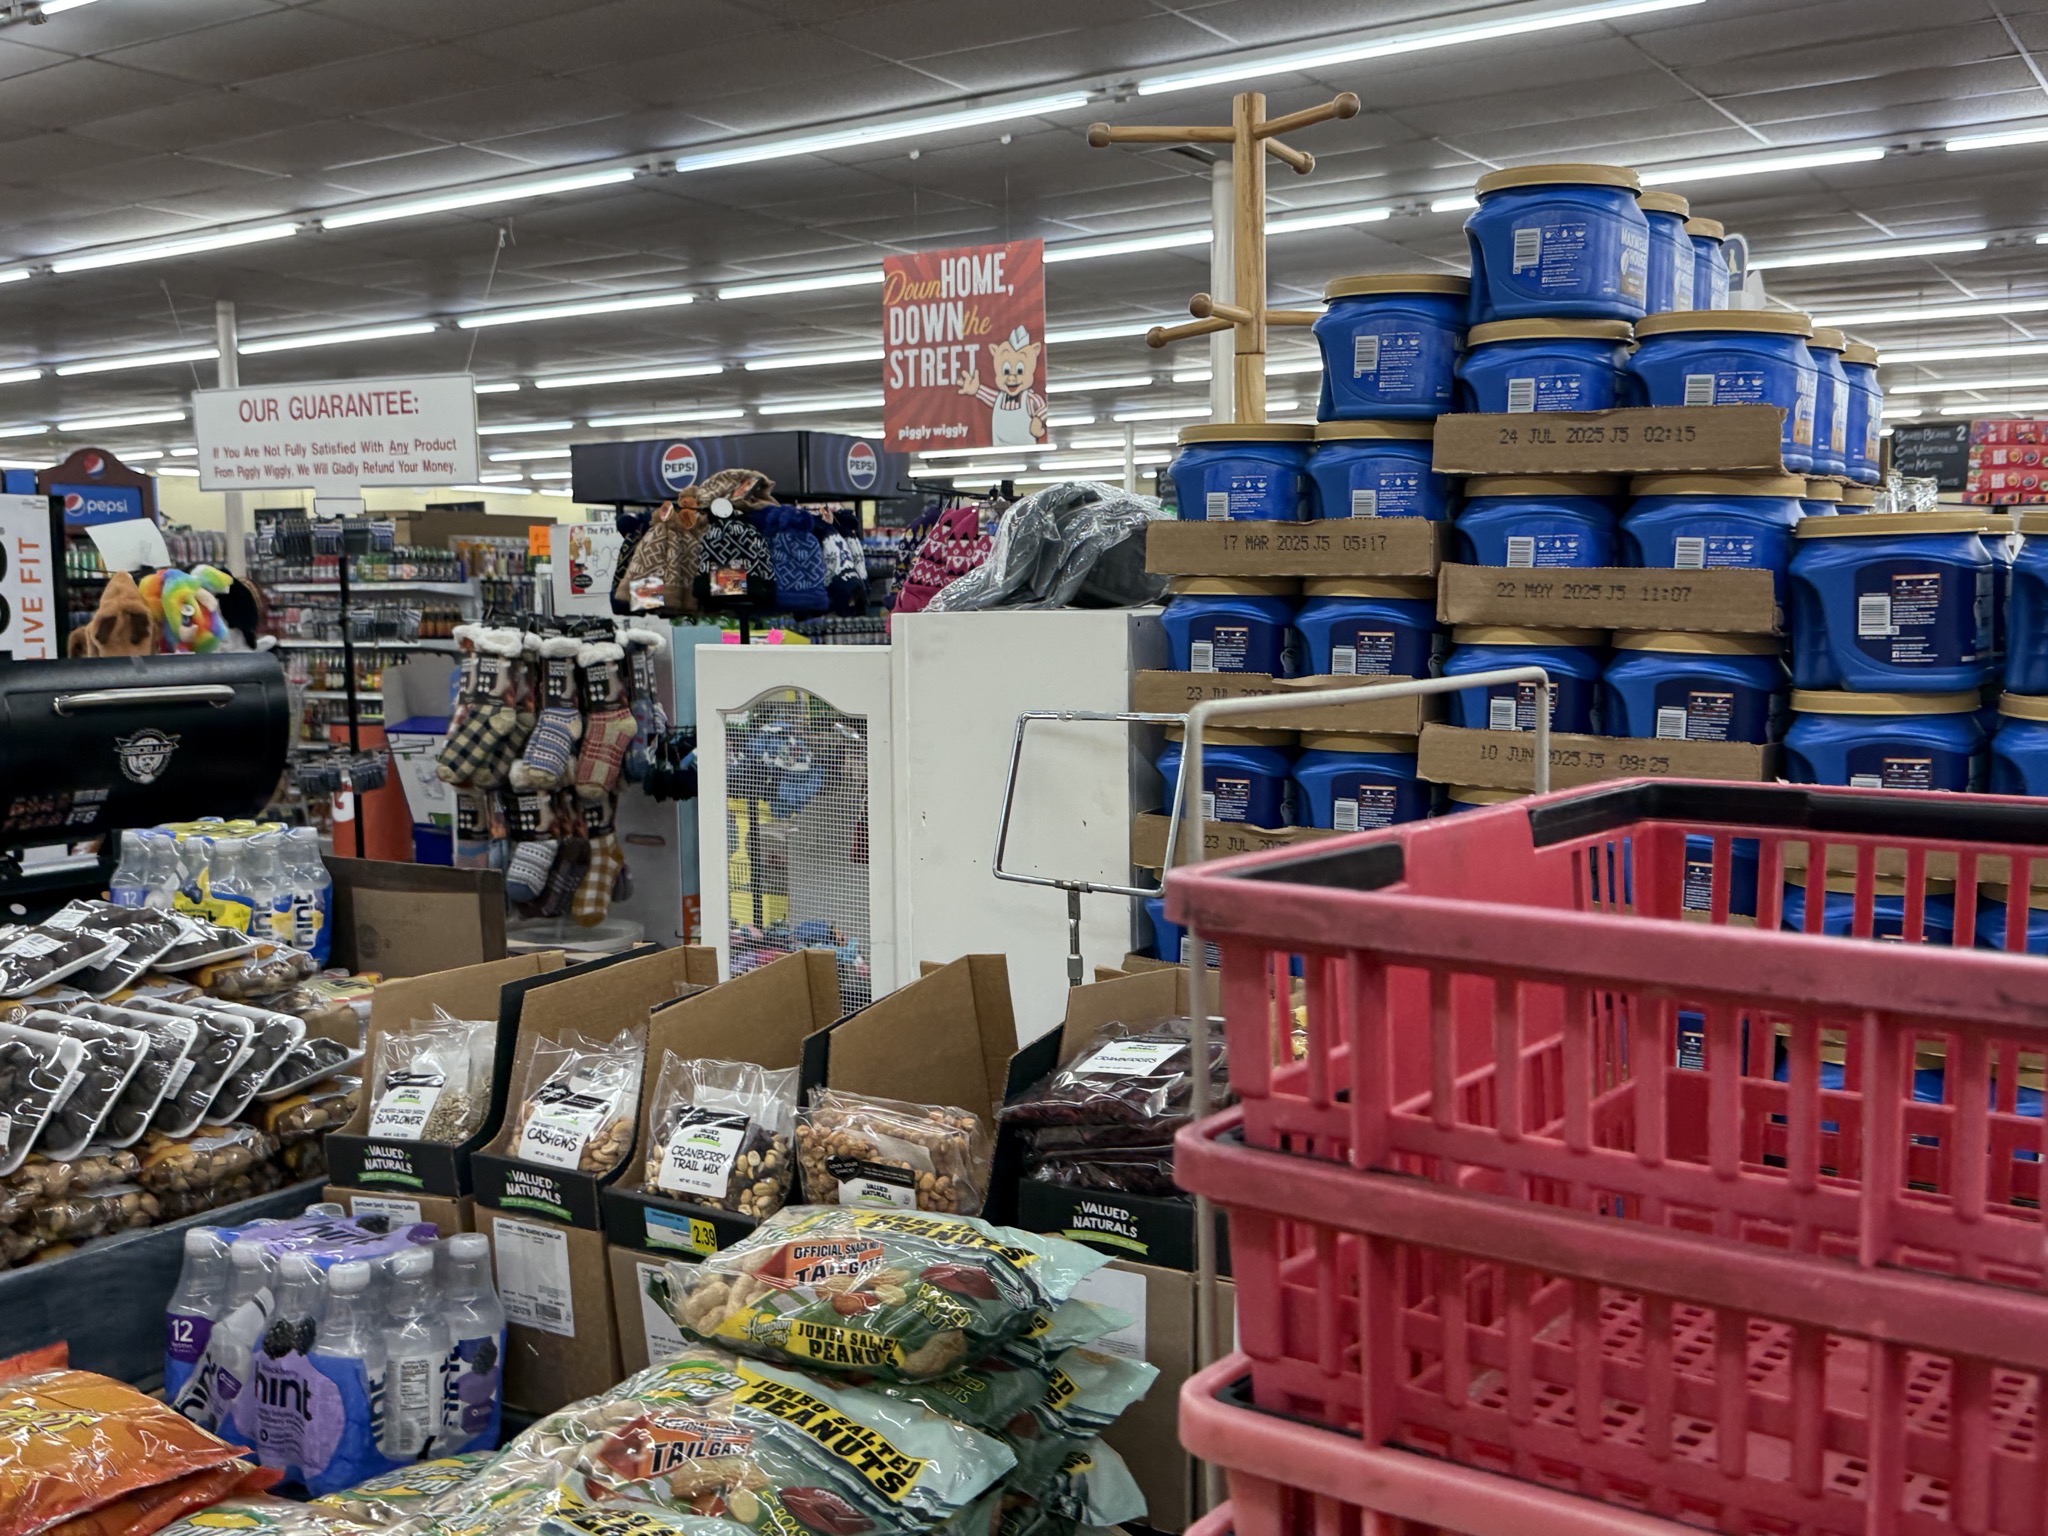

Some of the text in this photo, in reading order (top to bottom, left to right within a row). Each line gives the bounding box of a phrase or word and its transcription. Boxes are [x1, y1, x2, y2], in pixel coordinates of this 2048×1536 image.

[883, 252, 1014, 305] Down HOME,
[890, 301, 992, 345] DOWN the
[890, 344, 980, 389] STREET
[239, 390, 419, 423] OUR GUARANTEE:
[899, 423, 969, 440] piggly wiggly
[1500, 428, 1517, 444] 24
[1528, 427, 1556, 444] JUL
[1644, 425, 1696, 442] 02:15
[1956, 425, 1967, 441] 2
[224, 447, 240, 459] You
[244, 447, 260, 458] Are
[264, 446, 280, 457] Not
[285, 444, 307, 459] Fully
[312, 442, 356, 455] Satisfied
[361, 441, 384, 453] With
[389, 440, 409, 456] Any
[414, 438, 456, 452] Product
[215, 467, 234, 478] From
[237, 465, 261, 480] Piggly
[297, 463, 310, 475] We
[313, 463, 329, 475] Will
[332, 462, 359, 477] Gladly
[363, 461, 395, 474] Refund
[398, 460, 418, 473] Your
[422, 460, 457, 474] Money.
[664, 462, 695, 473] PEPSI
[849, 460, 876, 471] PEPSI
[87, 499, 128, 514] pepsi
[1224, 535, 1238, 550] 17
[1245, 536, 1270, 551] MAR
[1343, 535, 1387, 551] 05:17
[17, 537, 46, 659] LIVE FIT
[1497, 582, 1515, 598] 22
[1525, 583, 1552, 599] MAY
[1642, 585, 1692, 602] 11:07
[1187, 687, 1202, 700] 23
[1480, 744, 1498, 760] 10
[1506, 746, 1534, 763] JUN
[1618, 754, 1670, 773] 08:25
[1203, 836, 1219, 849] 23
[1227, 836, 1251, 852] JUL
[123, 892, 137, 905] 12
[375, 1113, 424, 1126] SUNFLOWER
[527, 1127, 577, 1152] CASHEWS
[368, 1145, 405, 1160] VALUED
[671, 1145, 730, 1165] CRANBERRY
[365, 1158, 413, 1174] NATURALS
[673, 1157, 721, 1175] TRAIL MIX
[511, 1169, 554, 1189] VALUED
[865, 1183, 889, 1193] VALUED
[506, 1182, 561, 1205] NATURALS
[861, 1189, 892, 1201] NATURALS
[1081, 1200, 1130, 1221] VALUED
[693, 1225, 716, 1247] 2.39
[1072, 1215, 1138, 1238] NATURALS
[793, 1243, 843, 1260] OFFICIAL
[845, 1241, 869, 1255] SNACK
[171, 1320, 193, 1342] 12
[747, 1316, 792, 1340] Hampton
[798, 1323, 844, 1344] JUMBO
[255, 1360, 313, 1421] hint
[752, 1380, 921, 1479] JUMBO SALTED
[743, 1391, 906, 1495] PEANUTS
